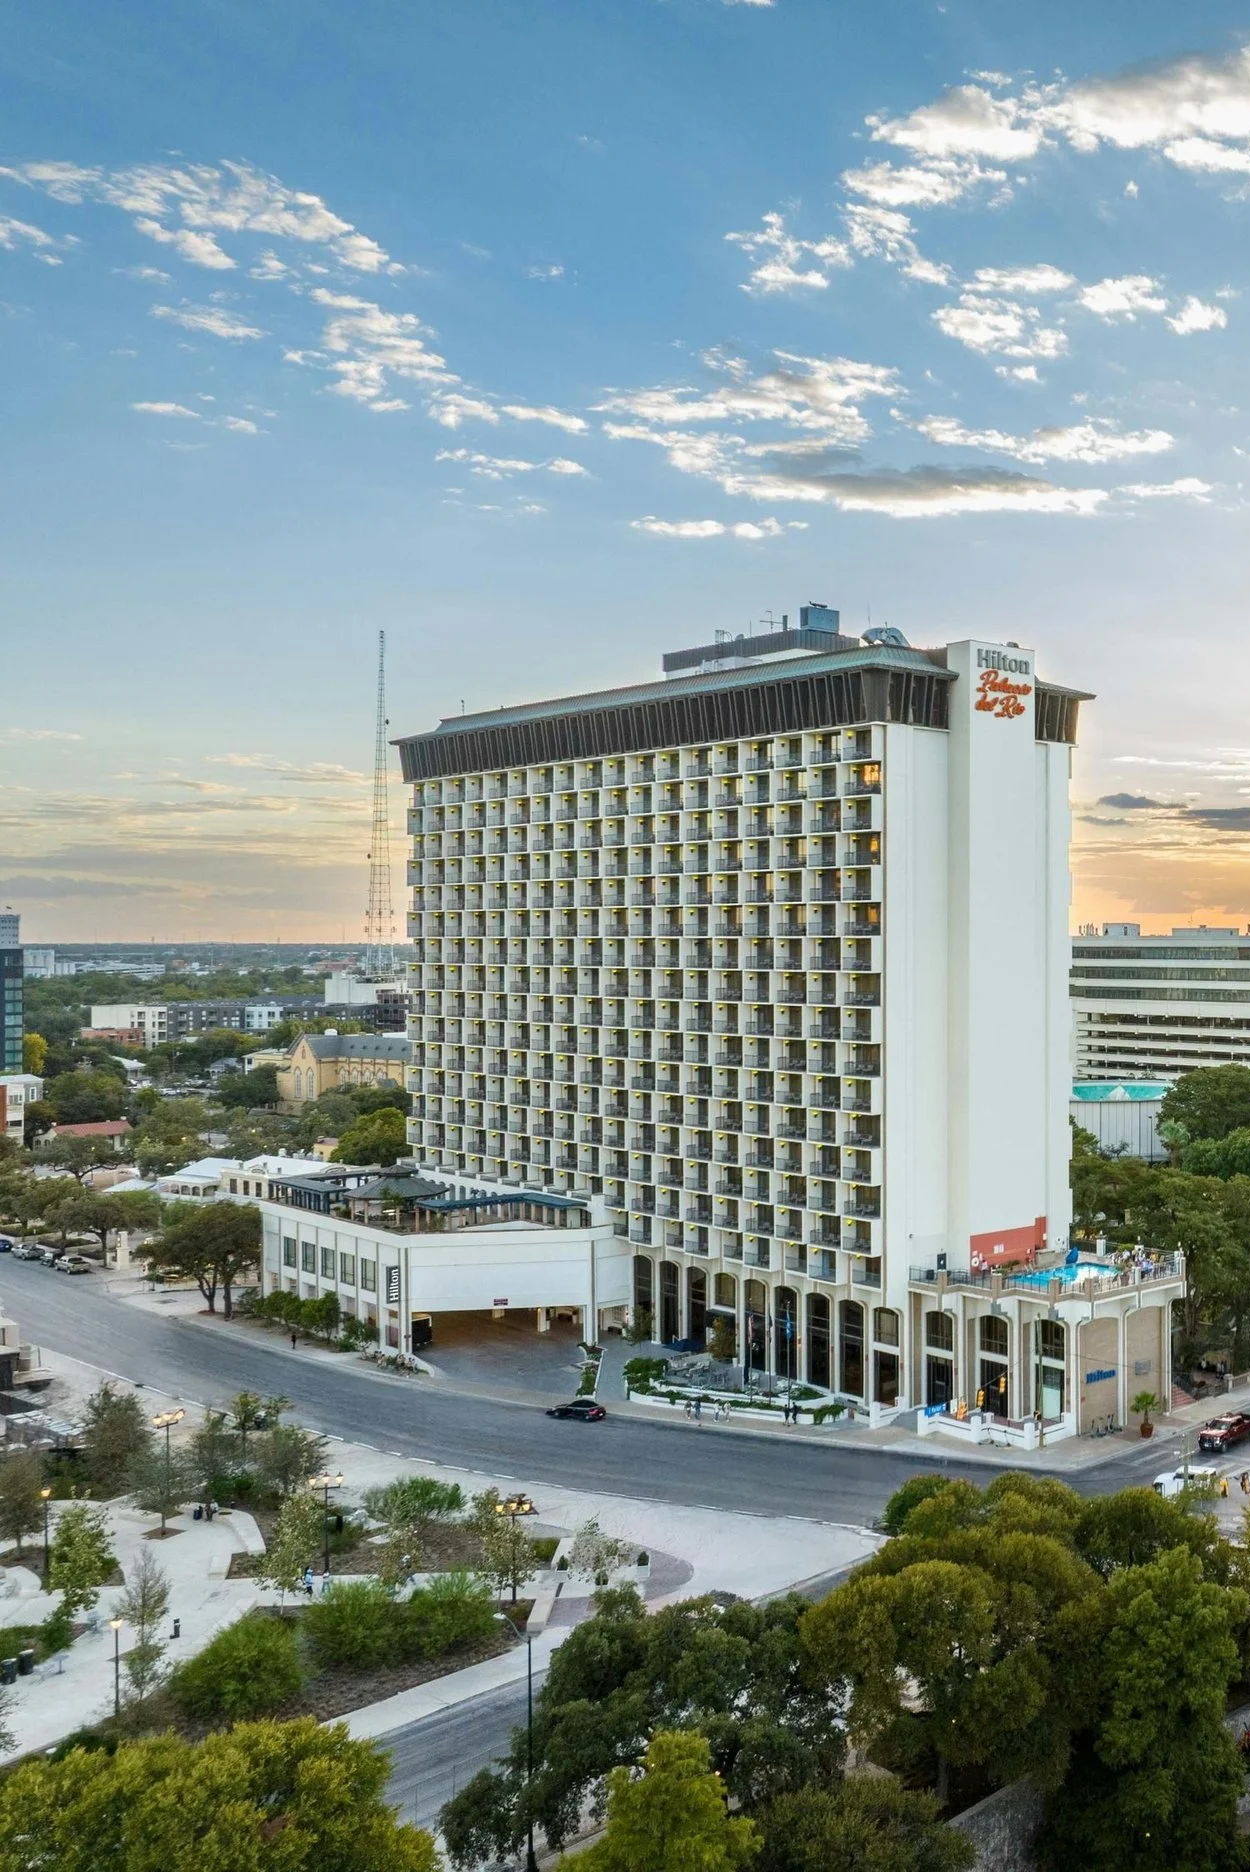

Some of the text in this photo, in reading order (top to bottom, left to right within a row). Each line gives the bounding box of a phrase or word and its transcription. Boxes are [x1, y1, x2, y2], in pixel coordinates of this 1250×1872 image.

[977, 648, 1030, 675] Hilton
[994, 695, 1025, 719] Rio
[389, 1269, 399, 1301] Hilton
[1086, 1370, 1117, 1384] Hilton
